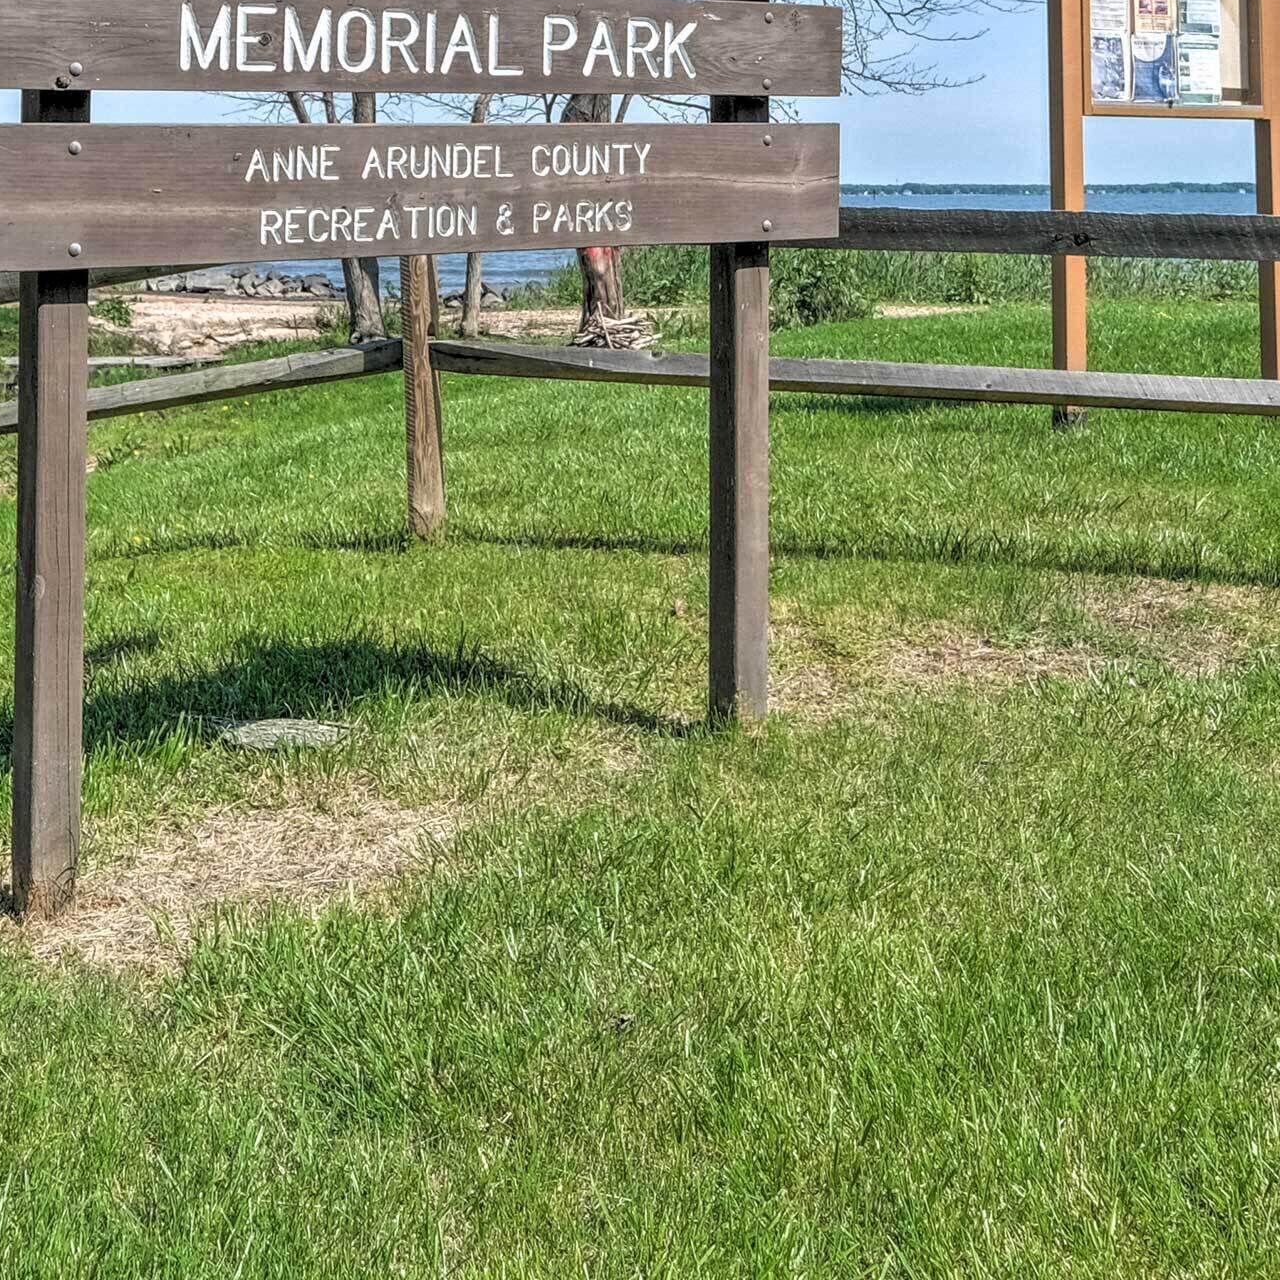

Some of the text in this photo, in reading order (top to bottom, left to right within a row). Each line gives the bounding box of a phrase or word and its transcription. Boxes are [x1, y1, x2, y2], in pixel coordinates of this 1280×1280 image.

[177, 0, 698, 79] MEMORIAL PARK
[244, 142, 651, 183] ANNE ARUNDEL COUNTY
[259, 199, 632, 245] RECREATION & PARKS
